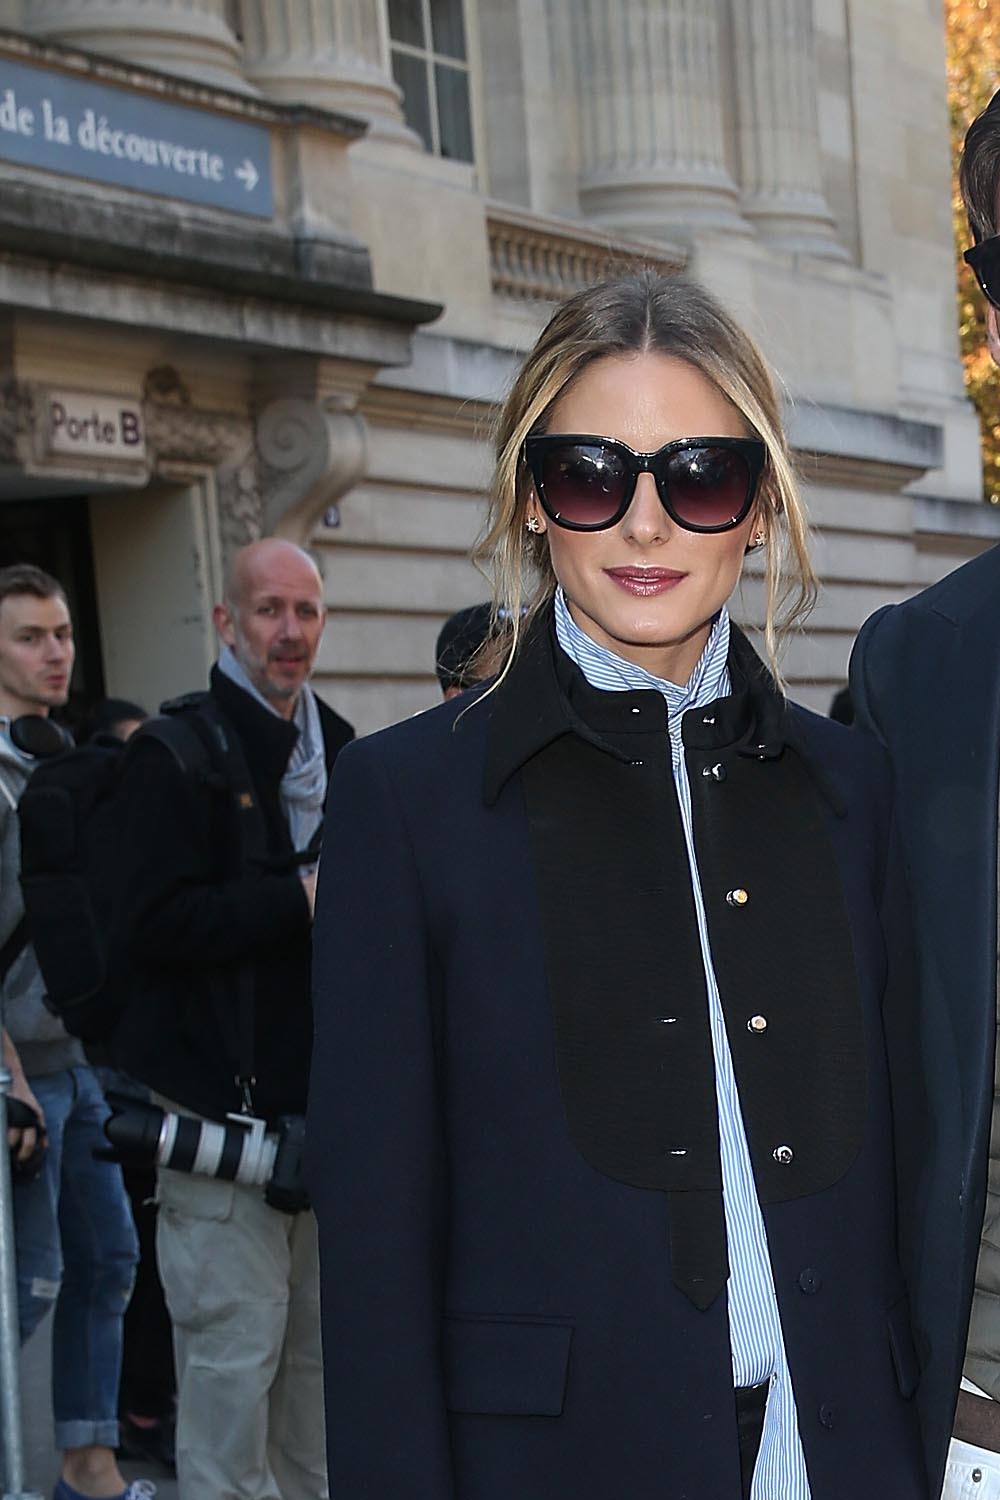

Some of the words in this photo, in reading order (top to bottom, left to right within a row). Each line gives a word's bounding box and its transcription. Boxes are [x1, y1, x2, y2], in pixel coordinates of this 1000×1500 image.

[0, 88, 35, 136] de
[41, 98, 71, 146] la
[78, 108, 225, 183] découverte
[50, 401, 116, 444] Porte
[120, 410, 141, 446] B
